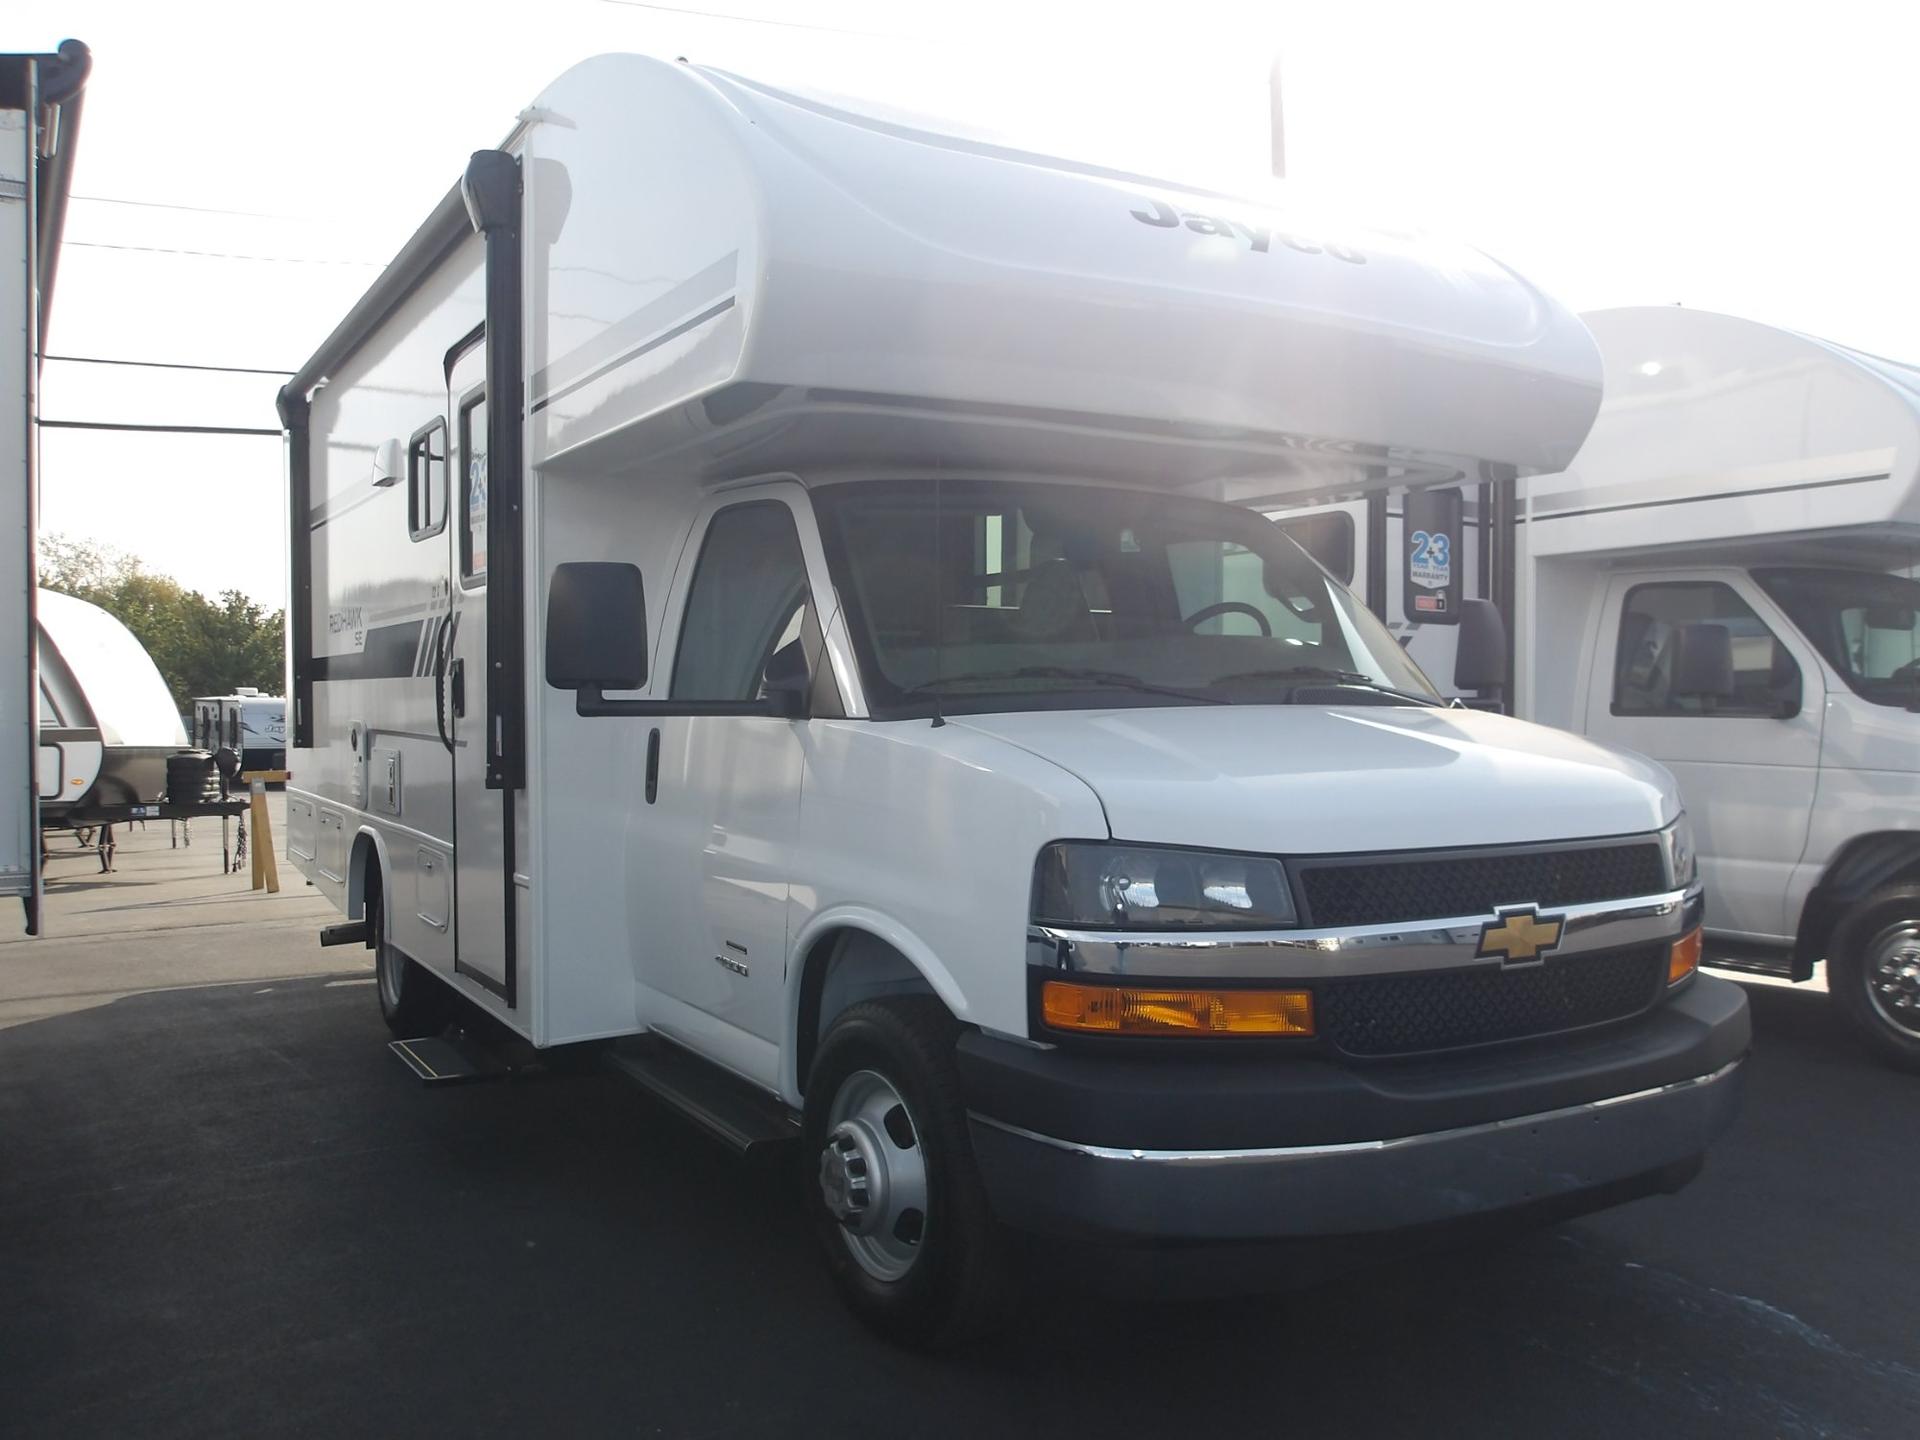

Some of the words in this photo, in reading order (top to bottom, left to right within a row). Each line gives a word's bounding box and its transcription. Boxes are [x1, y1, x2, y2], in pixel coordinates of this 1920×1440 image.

[1129, 200, 1367, 265] Jayco
[1412, 571, 1448, 581] WARRANTY
[329, 606, 362, 633] REDHAWK
[355, 631, 362, 646] SE
